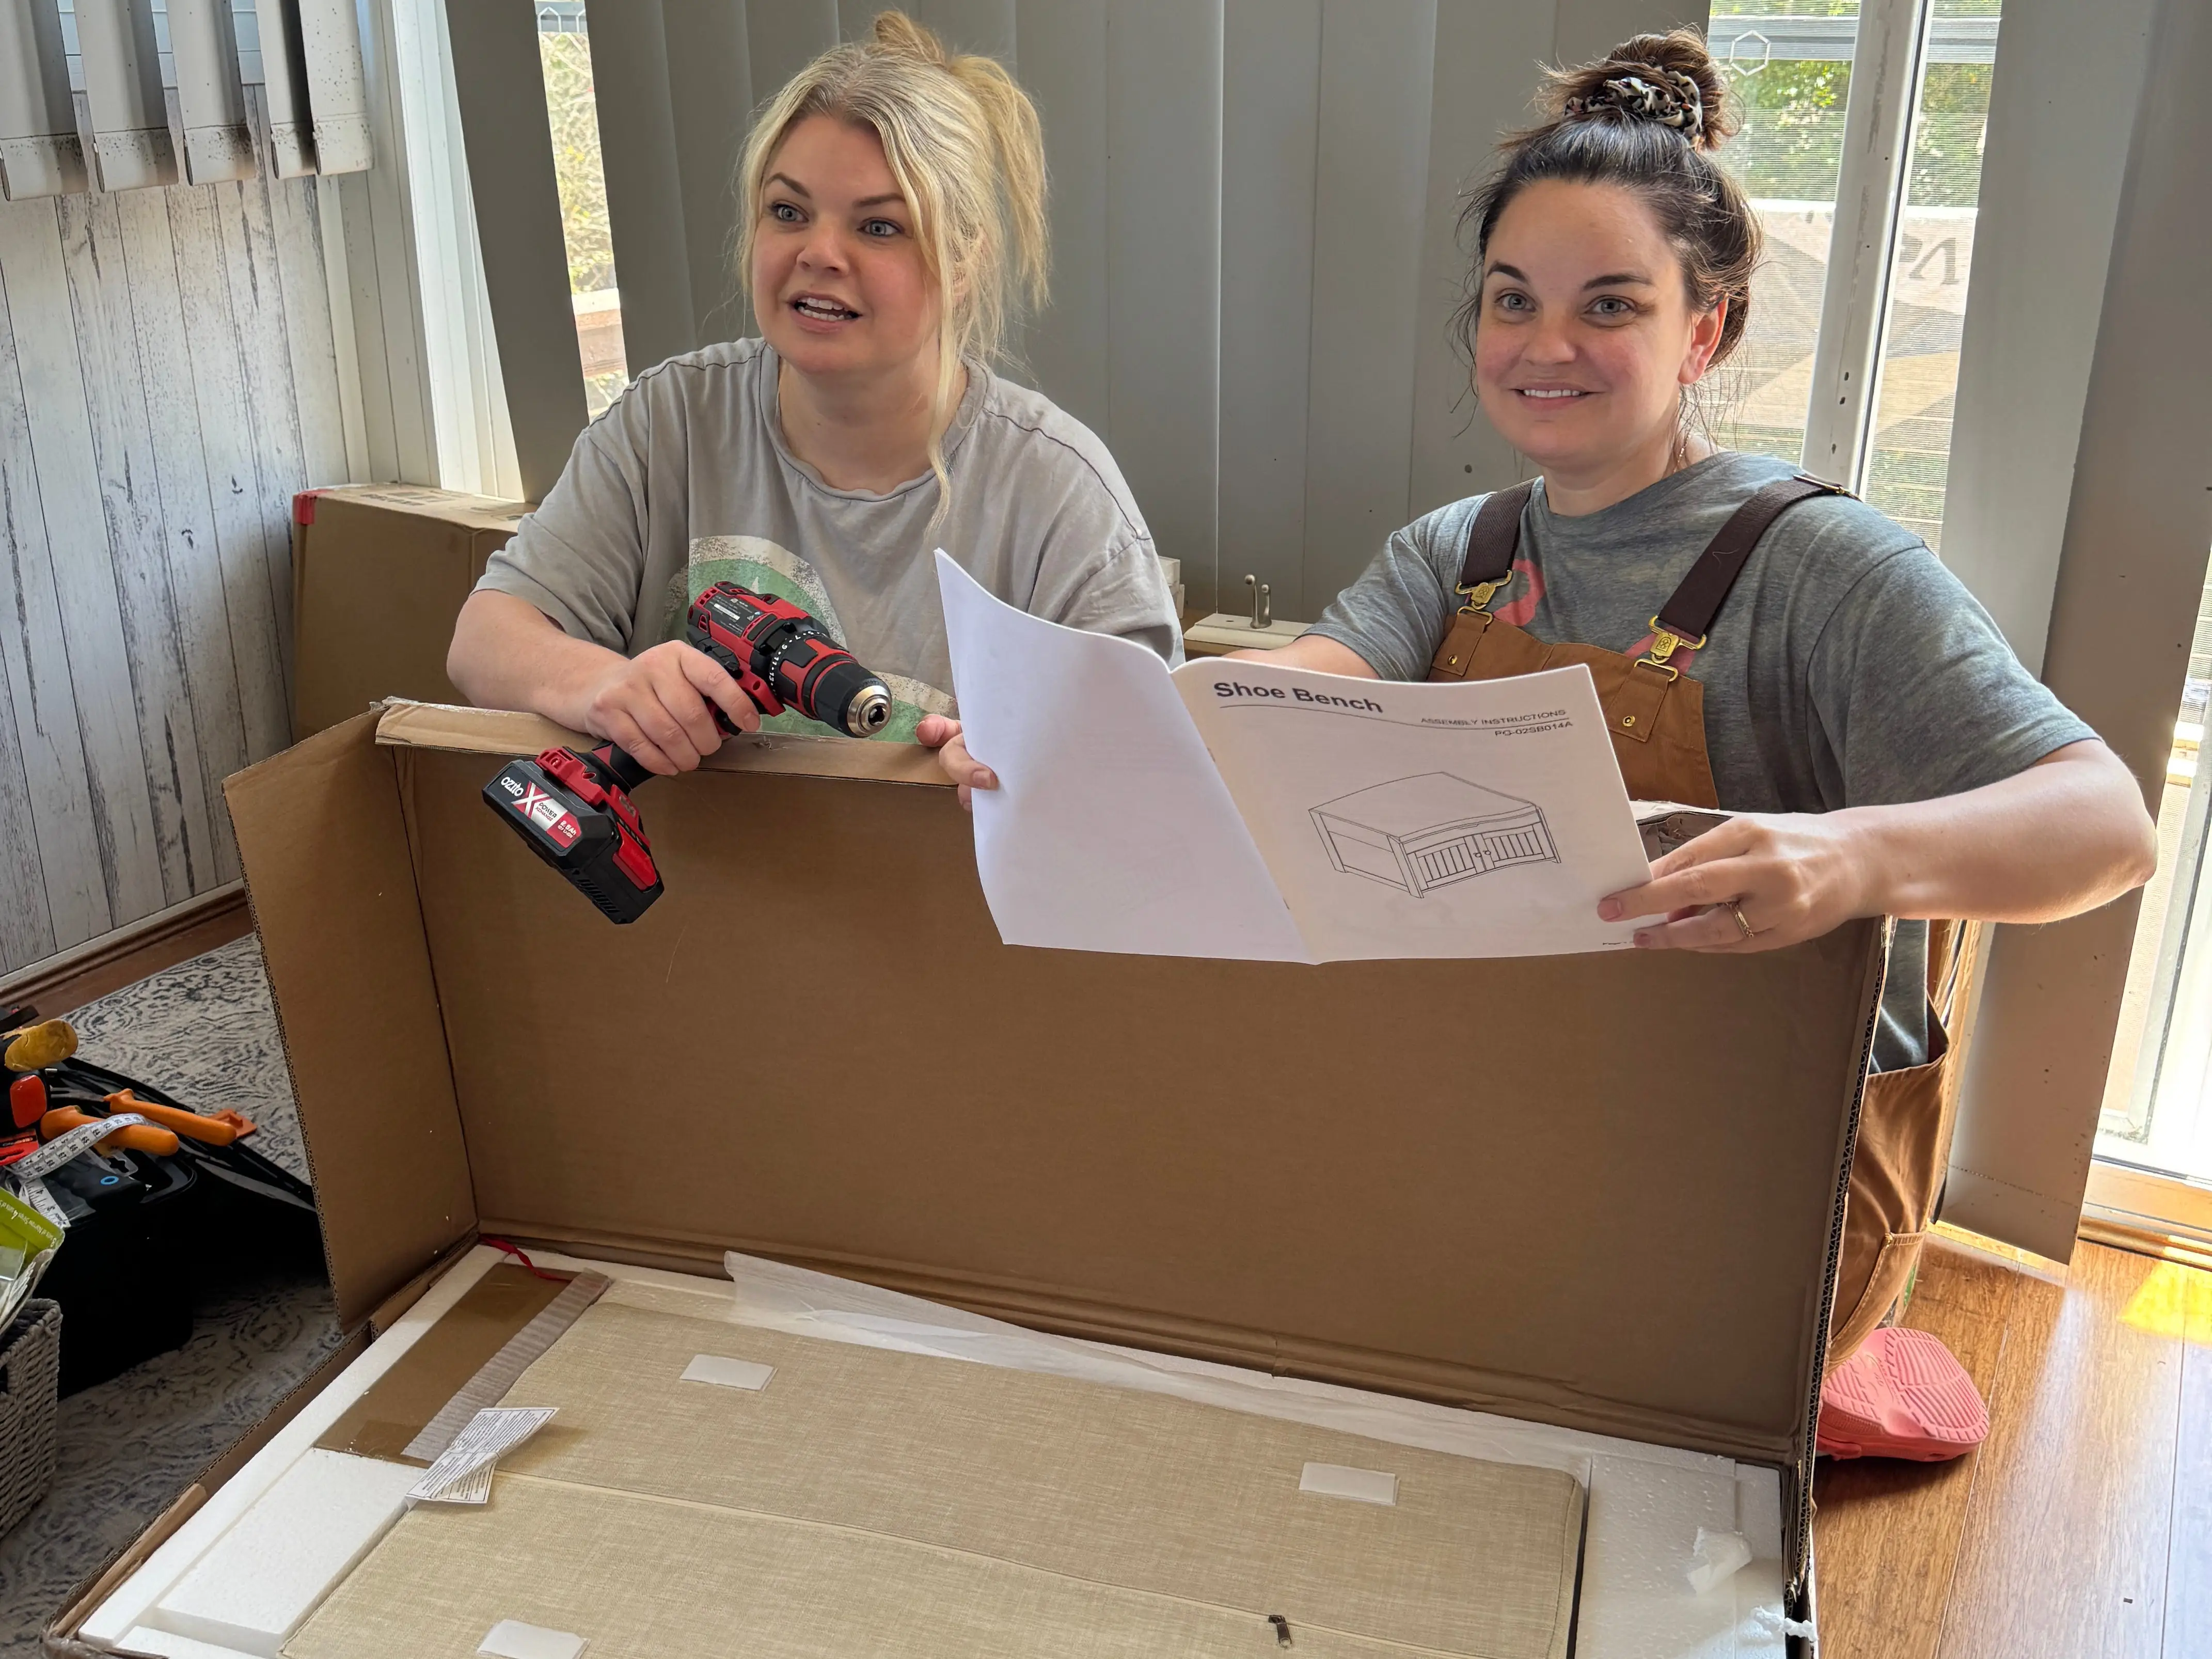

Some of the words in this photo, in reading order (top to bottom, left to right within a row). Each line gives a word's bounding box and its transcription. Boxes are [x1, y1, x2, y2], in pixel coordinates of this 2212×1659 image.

[1214, 682, 1286, 699] Shoe
[1292, 688, 1383, 713] Bench
[1421, 717, 1478, 725] ASSEMBLY
[1481, 709, 1567, 725] INSTRUCTIONS
[500, 777, 524, 797] ozito
[539, 802, 557, 818] POWER
[11, 1209, 19, 1220] 4
[50, 1237, 57, 1247] 8
